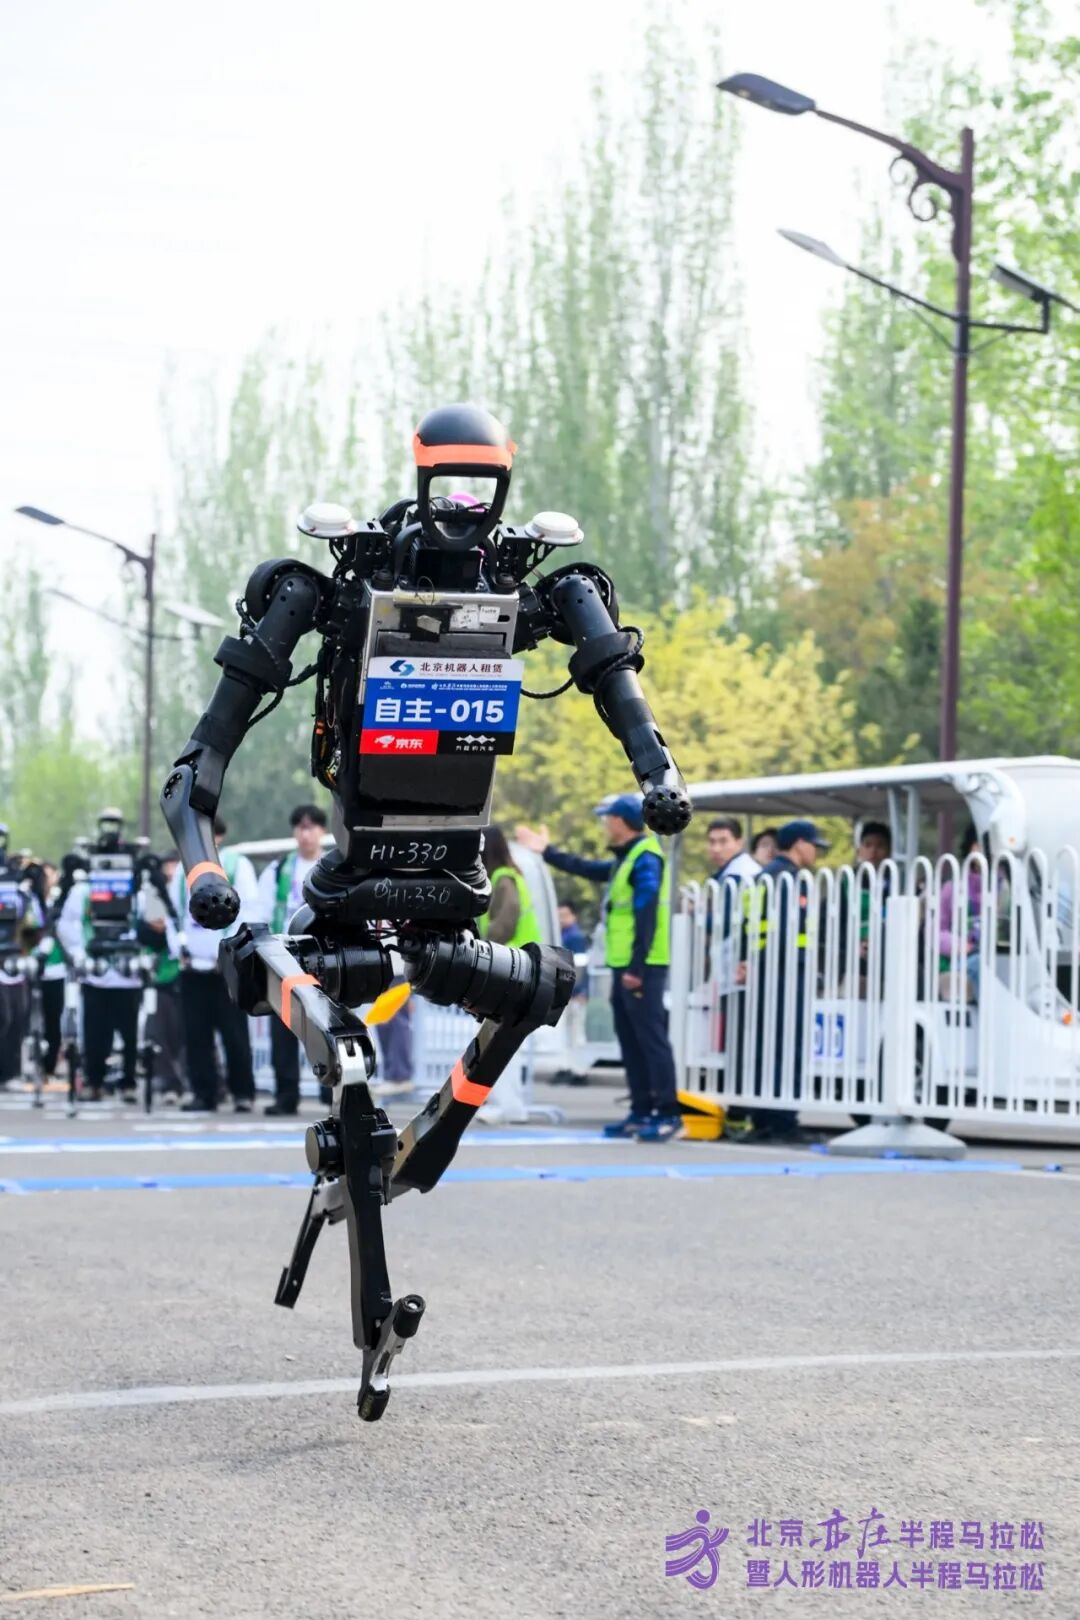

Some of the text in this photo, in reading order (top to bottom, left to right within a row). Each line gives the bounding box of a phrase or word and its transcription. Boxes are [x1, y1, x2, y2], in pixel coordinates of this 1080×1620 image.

[420, 661, 503, 673] 北京机器人租赁
[375, 697, 504, 723] 自主-015
[395, 738, 424, 749] 京东
